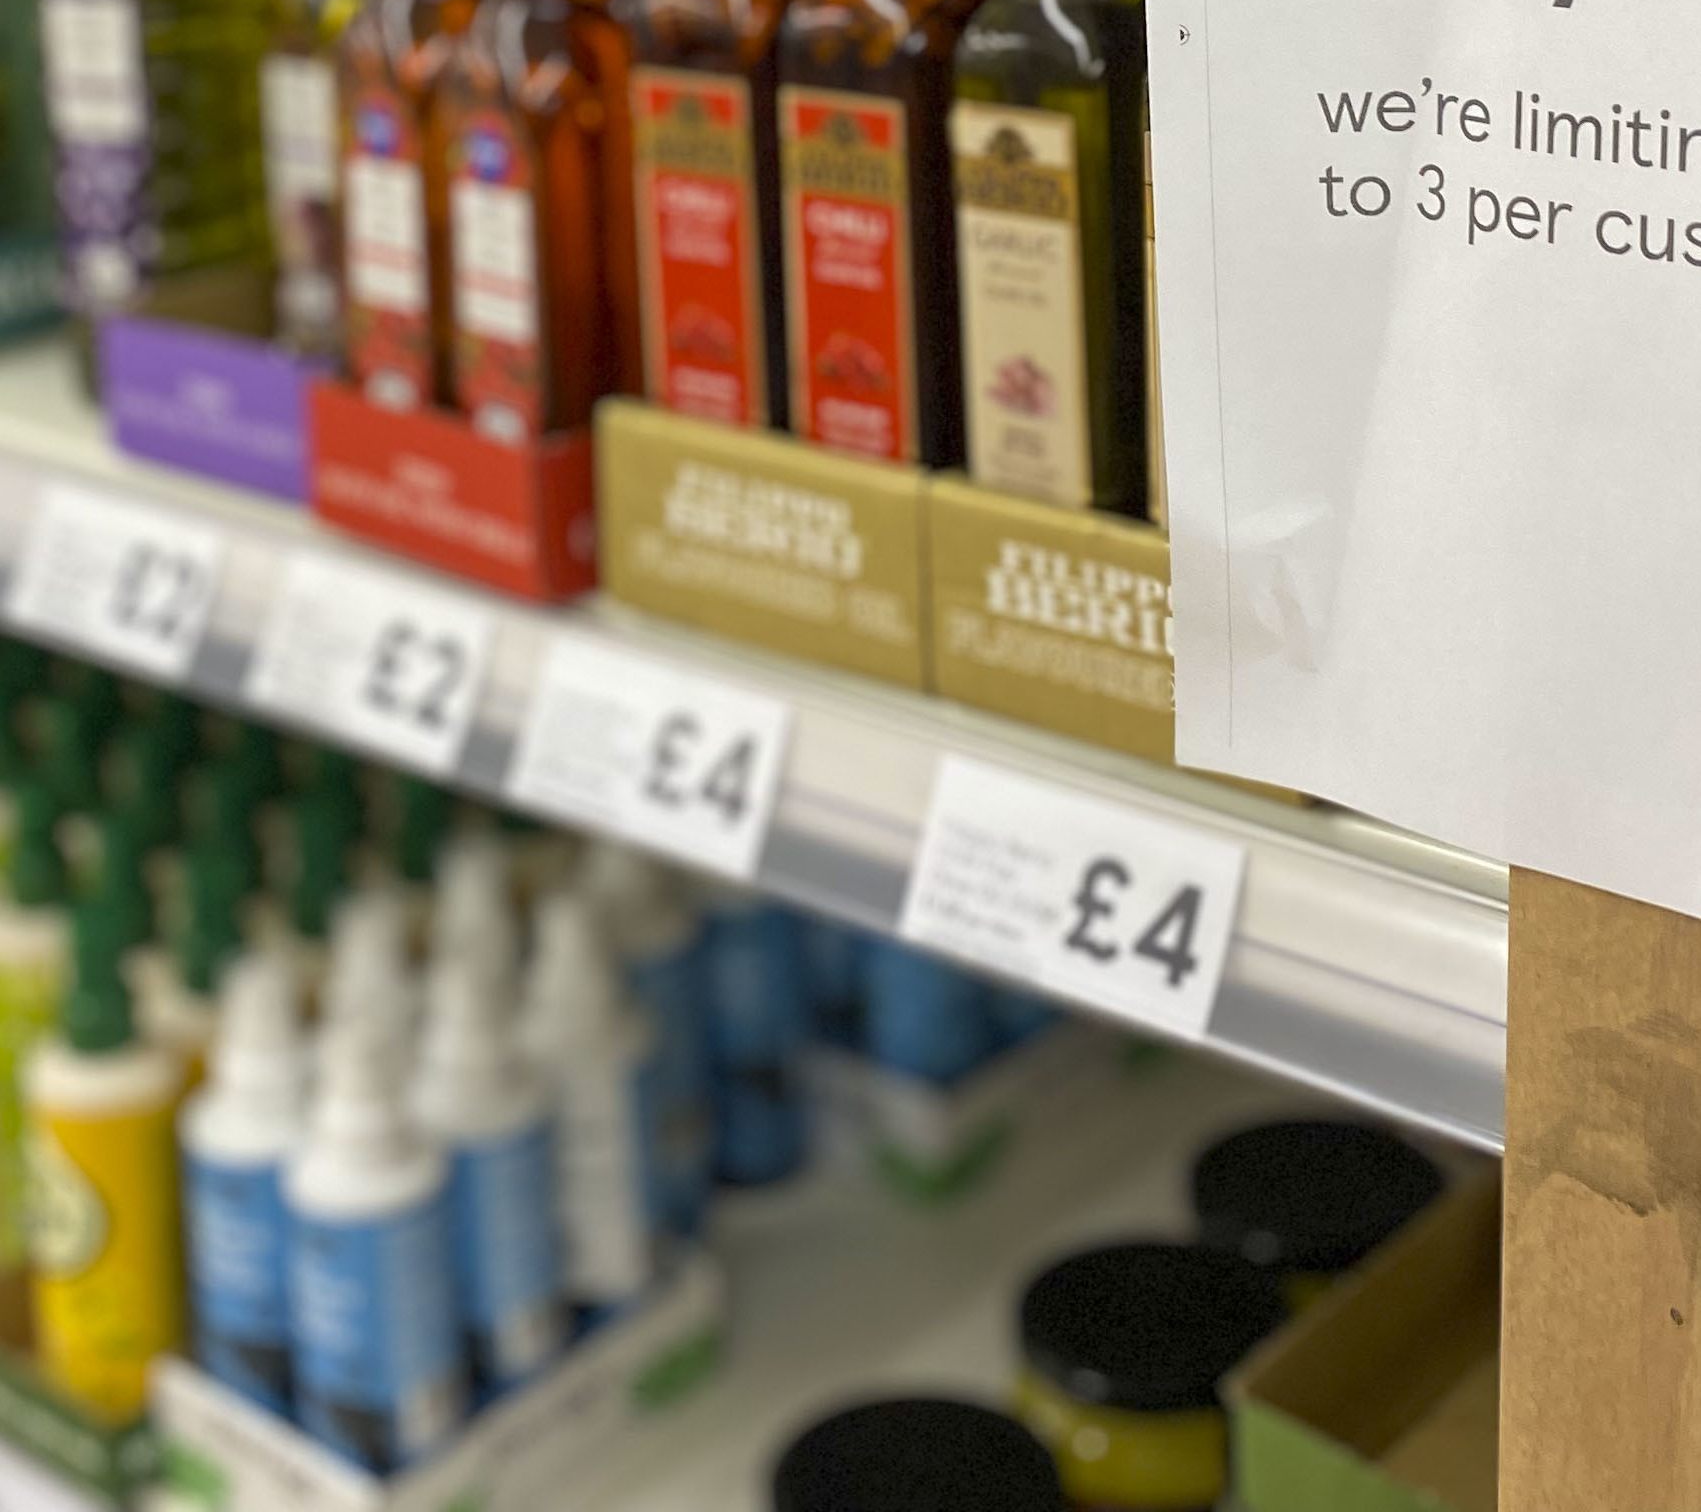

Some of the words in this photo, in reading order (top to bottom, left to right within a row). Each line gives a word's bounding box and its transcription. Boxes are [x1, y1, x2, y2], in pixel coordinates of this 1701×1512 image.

[1317, 77, 1491, 143] we’re
[1318, 166, 1391, 217] to
[1416, 164, 1445, 221] 3
[1468, 187, 1573, 245] per
[986, 566, 1174, 657] BERI
[1001, 542, 1173, 610] FILIPP
[366, 617, 468, 730] £2
[643, 709, 758, 828] £4
[1065, 856, 1204, 988] £4
